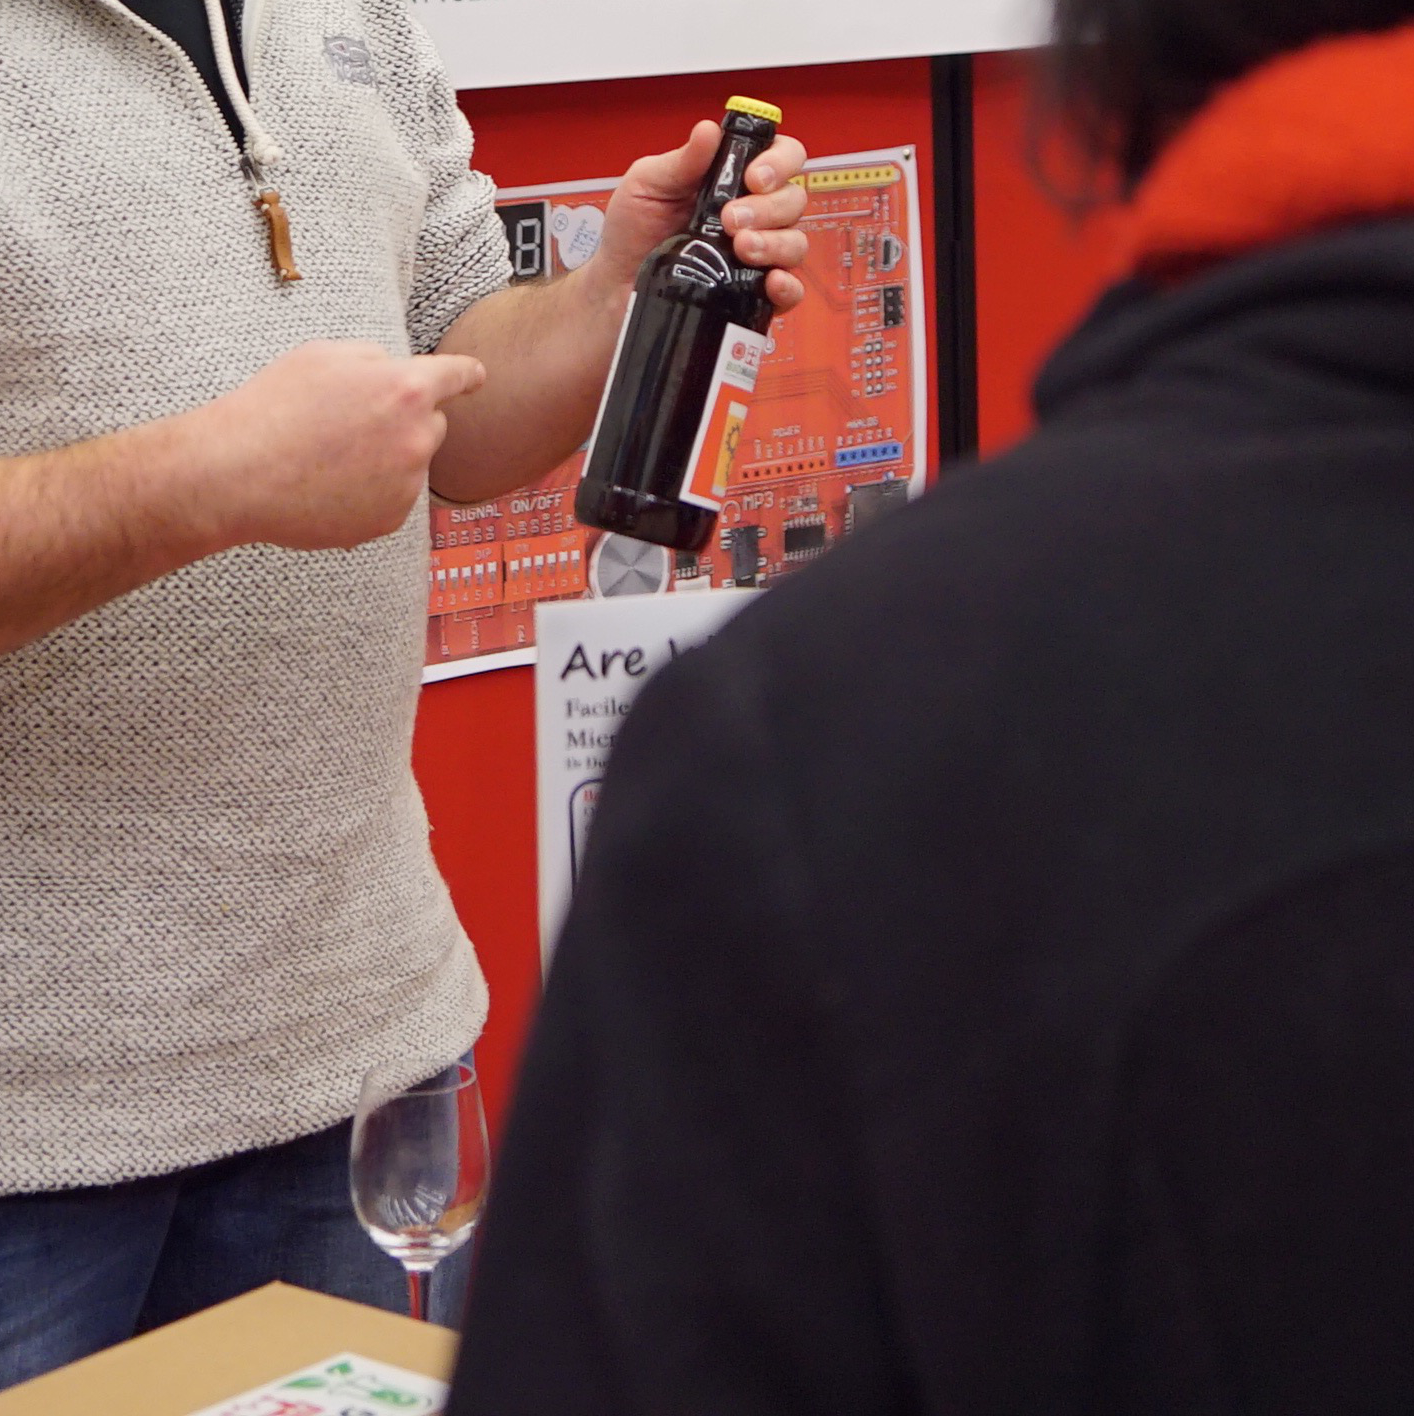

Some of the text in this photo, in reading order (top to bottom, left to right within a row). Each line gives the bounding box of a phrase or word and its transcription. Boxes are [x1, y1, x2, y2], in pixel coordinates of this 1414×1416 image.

[450, 493, 564, 523] SIGNAL ON/OFF
[742, 491, 774, 511] MP3
[559, 642, 647, 681] Are
